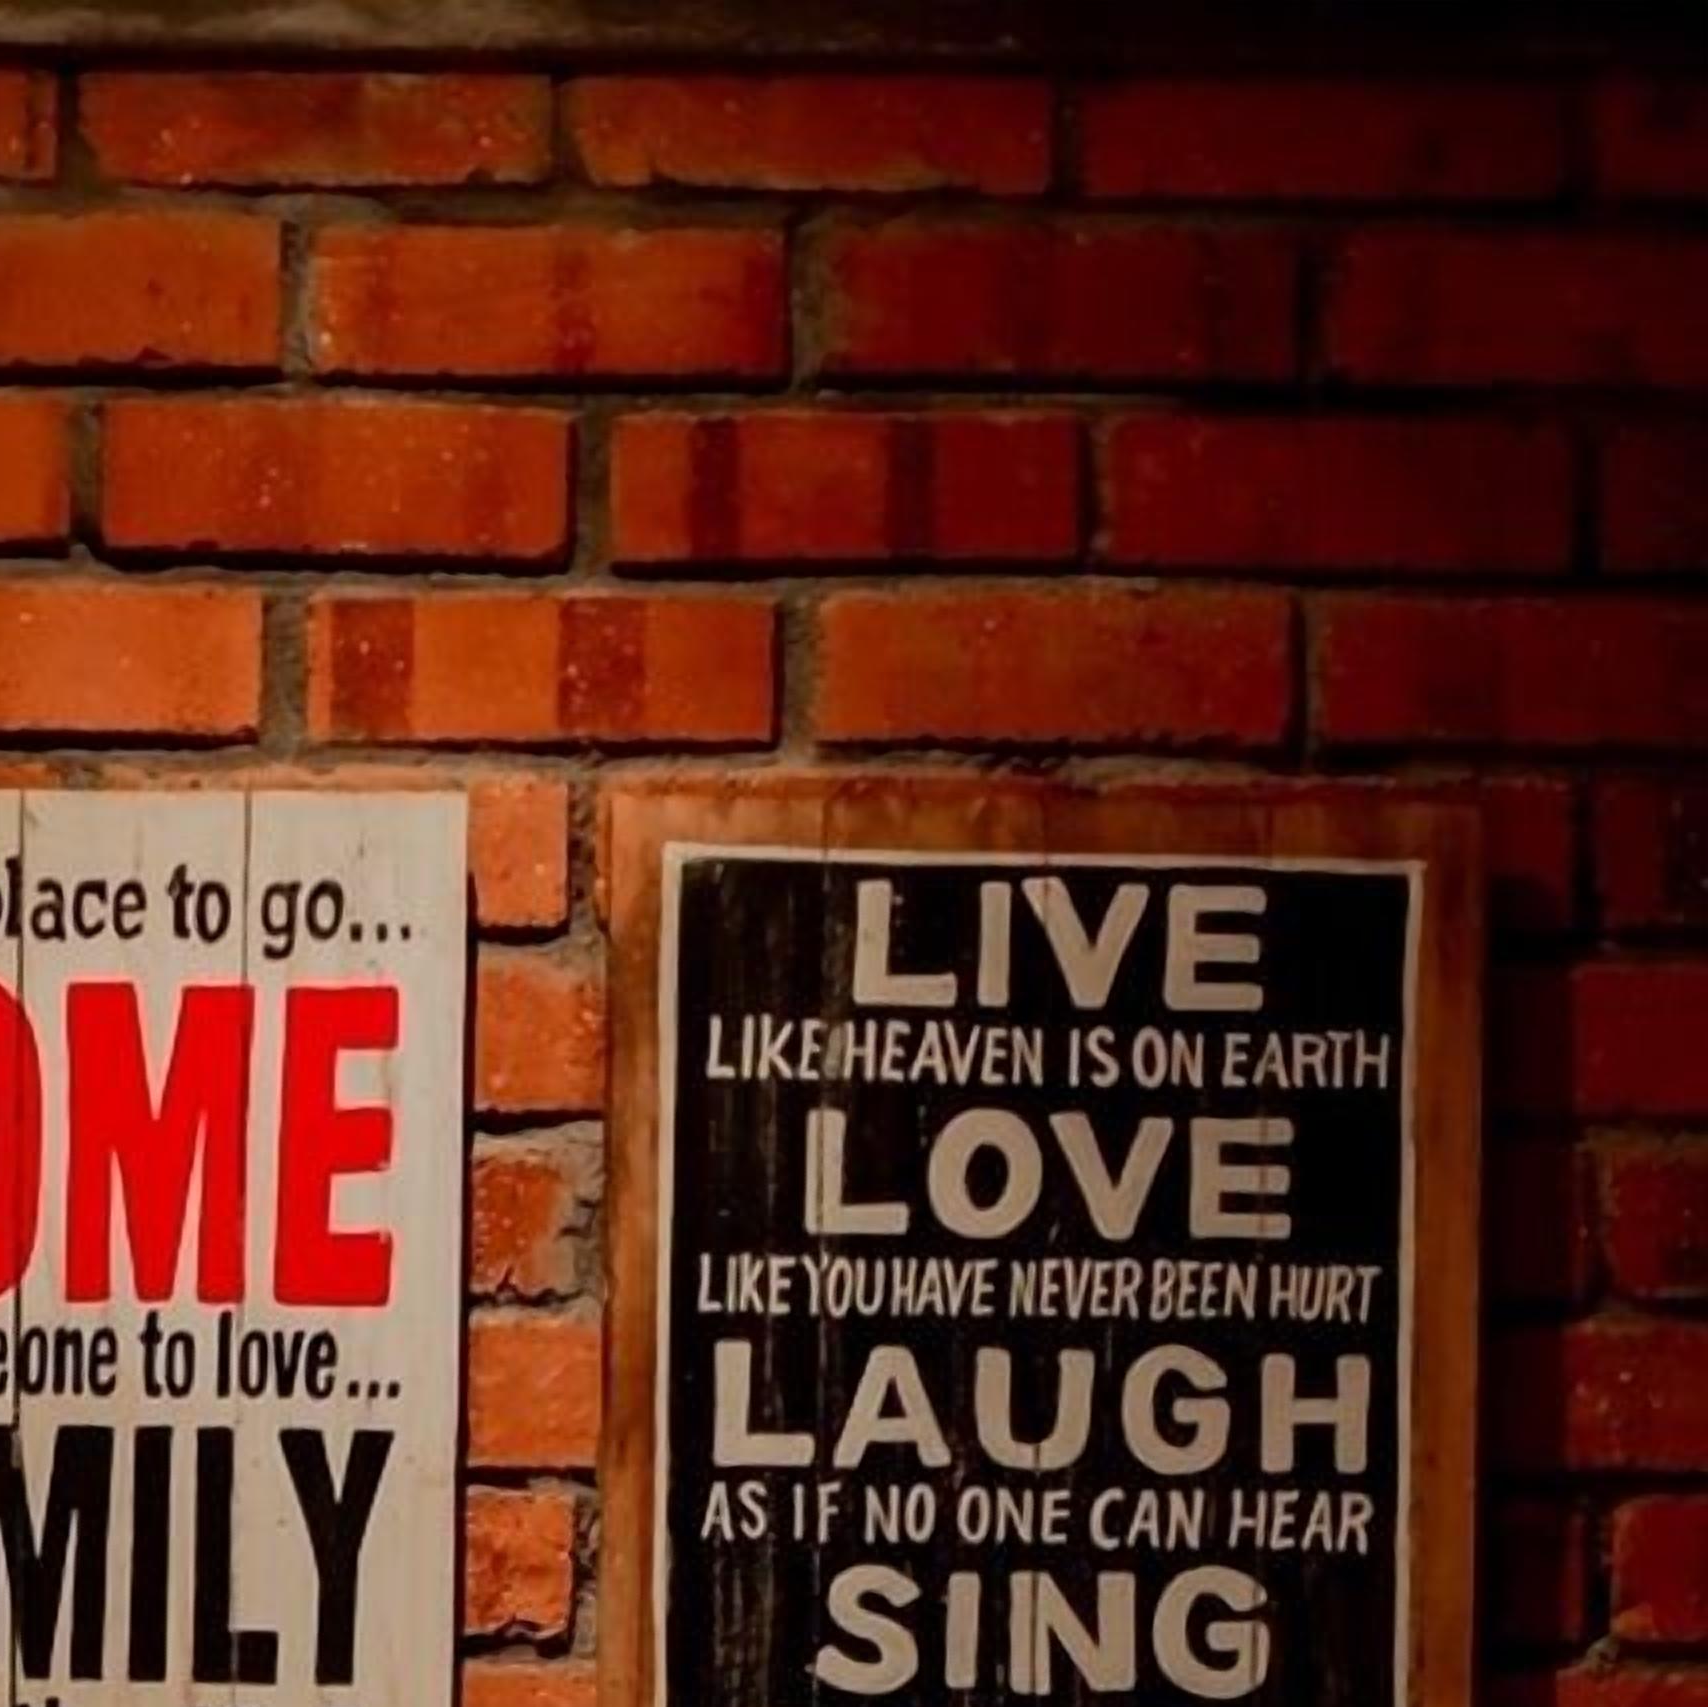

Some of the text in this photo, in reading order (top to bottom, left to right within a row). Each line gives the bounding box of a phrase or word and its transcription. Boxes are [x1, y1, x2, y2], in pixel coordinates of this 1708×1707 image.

[166, 862, 229, 941] to
[851, 877, 1268, 1012] LIVE
[705, 1014, 1390, 1091] LIKE HEAVEN IS ON EARTH
[804, 1106, 1293, 1240] LOVE
[699, 1254, 1382, 1325] LIKE YOU HAVE NEVER BEEN HURT
[140, 1311, 198, 1399] to
[711, 1339, 1373, 1475] LAUGH
[702, 1484, 1374, 1555] AS IF NO ONE CAN HEAR
[811, 1564, 1271, 1699] SING
